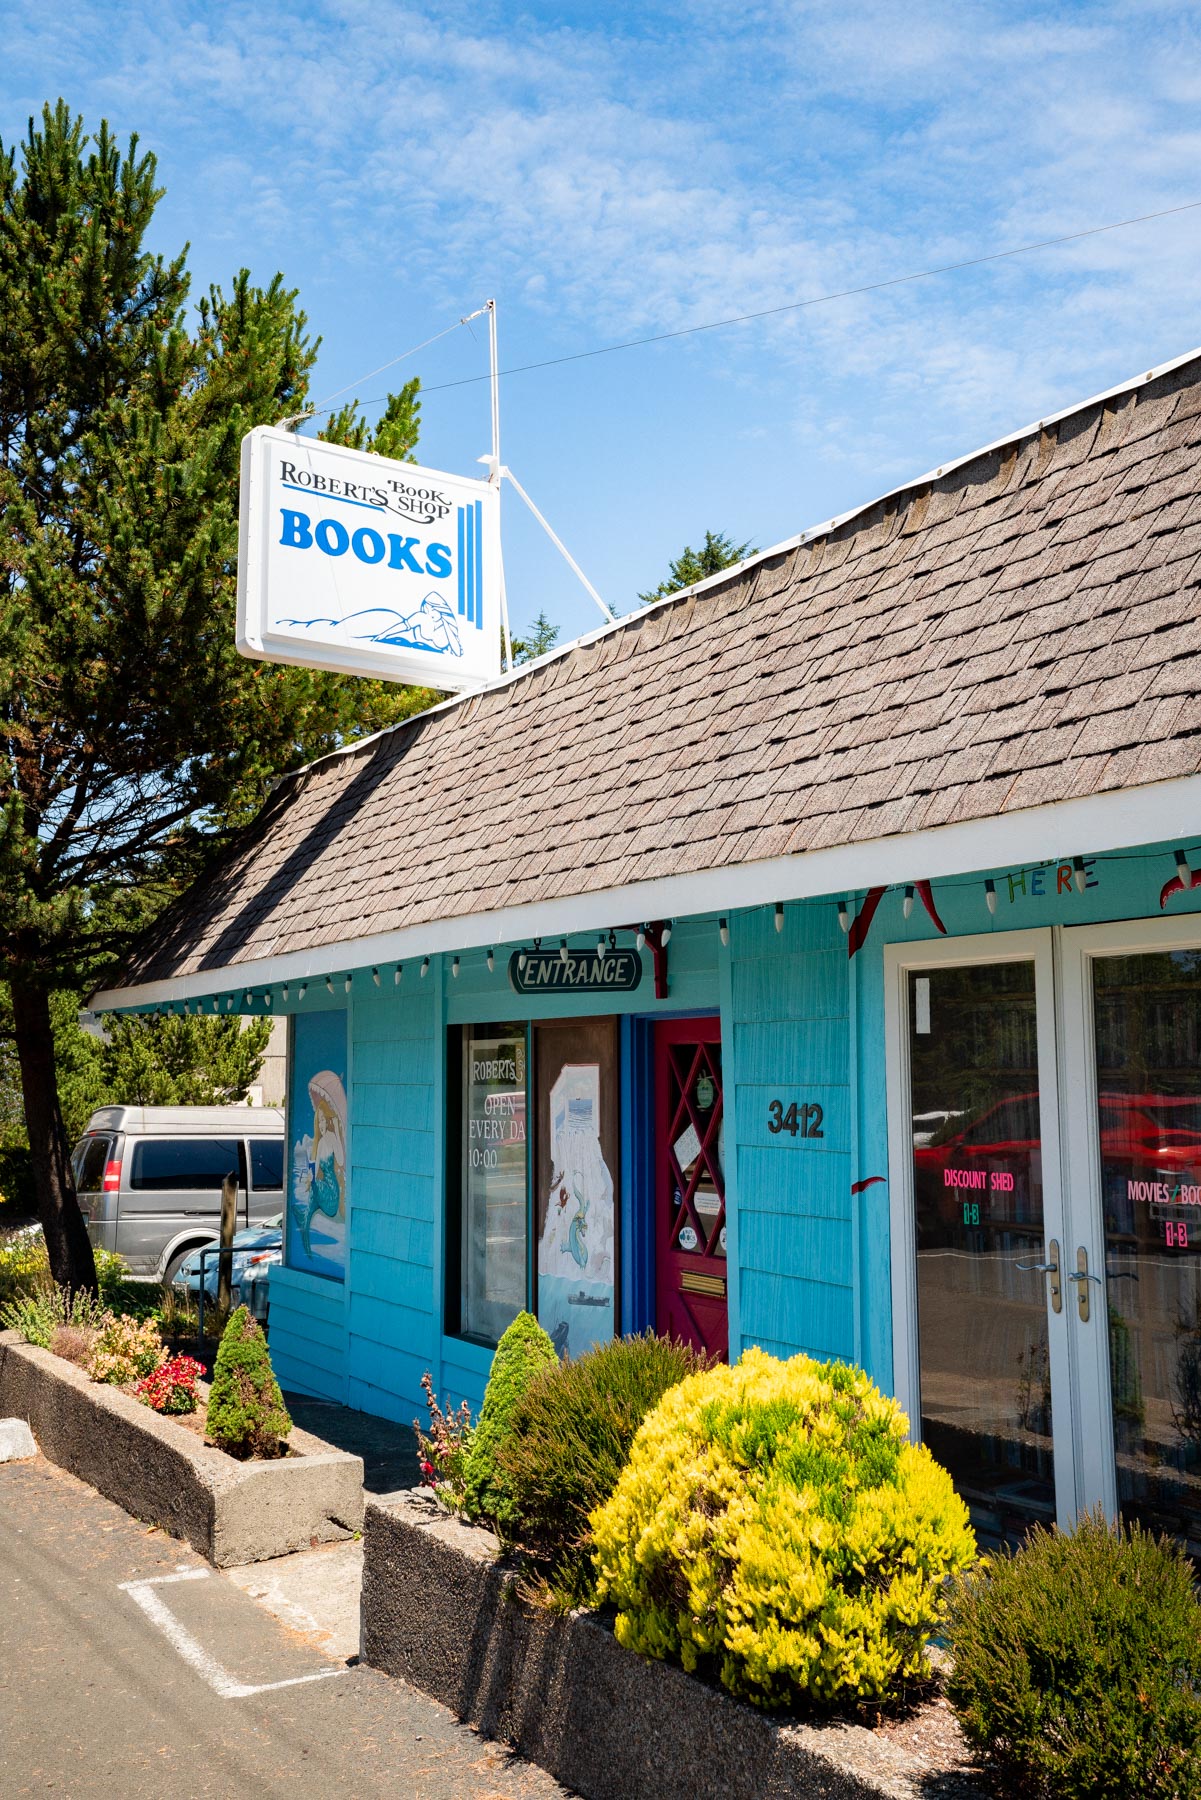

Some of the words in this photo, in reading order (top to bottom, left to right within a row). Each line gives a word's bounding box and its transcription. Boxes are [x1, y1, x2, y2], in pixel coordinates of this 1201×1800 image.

[279, 460, 390, 508] ROBERT'S
[387, 480, 453, 506] BOOK
[398, 496, 450, 519] SHOP
[279, 508, 453, 579] BOOKS
[523, 958, 628, 985] ENTRANCE
[473, 1058, 523, 1082] ROBERT'S
[484, 1095, 516, 1116] OPEN
[469, 1119, 506, 1140] EVERY
[767, 1099, 824, 1138] 3412
[468, 1148, 497, 1168] 10:00
[944, 1169, 987, 1189] DISCOUNT
[991, 1172, 1014, 1192] SHED
[1127, 1180, 1170, 1203] MOVIES
[963, 1202, 980, 1226] 1-3
[1165, 1221, 1188, 1248] 1-3
